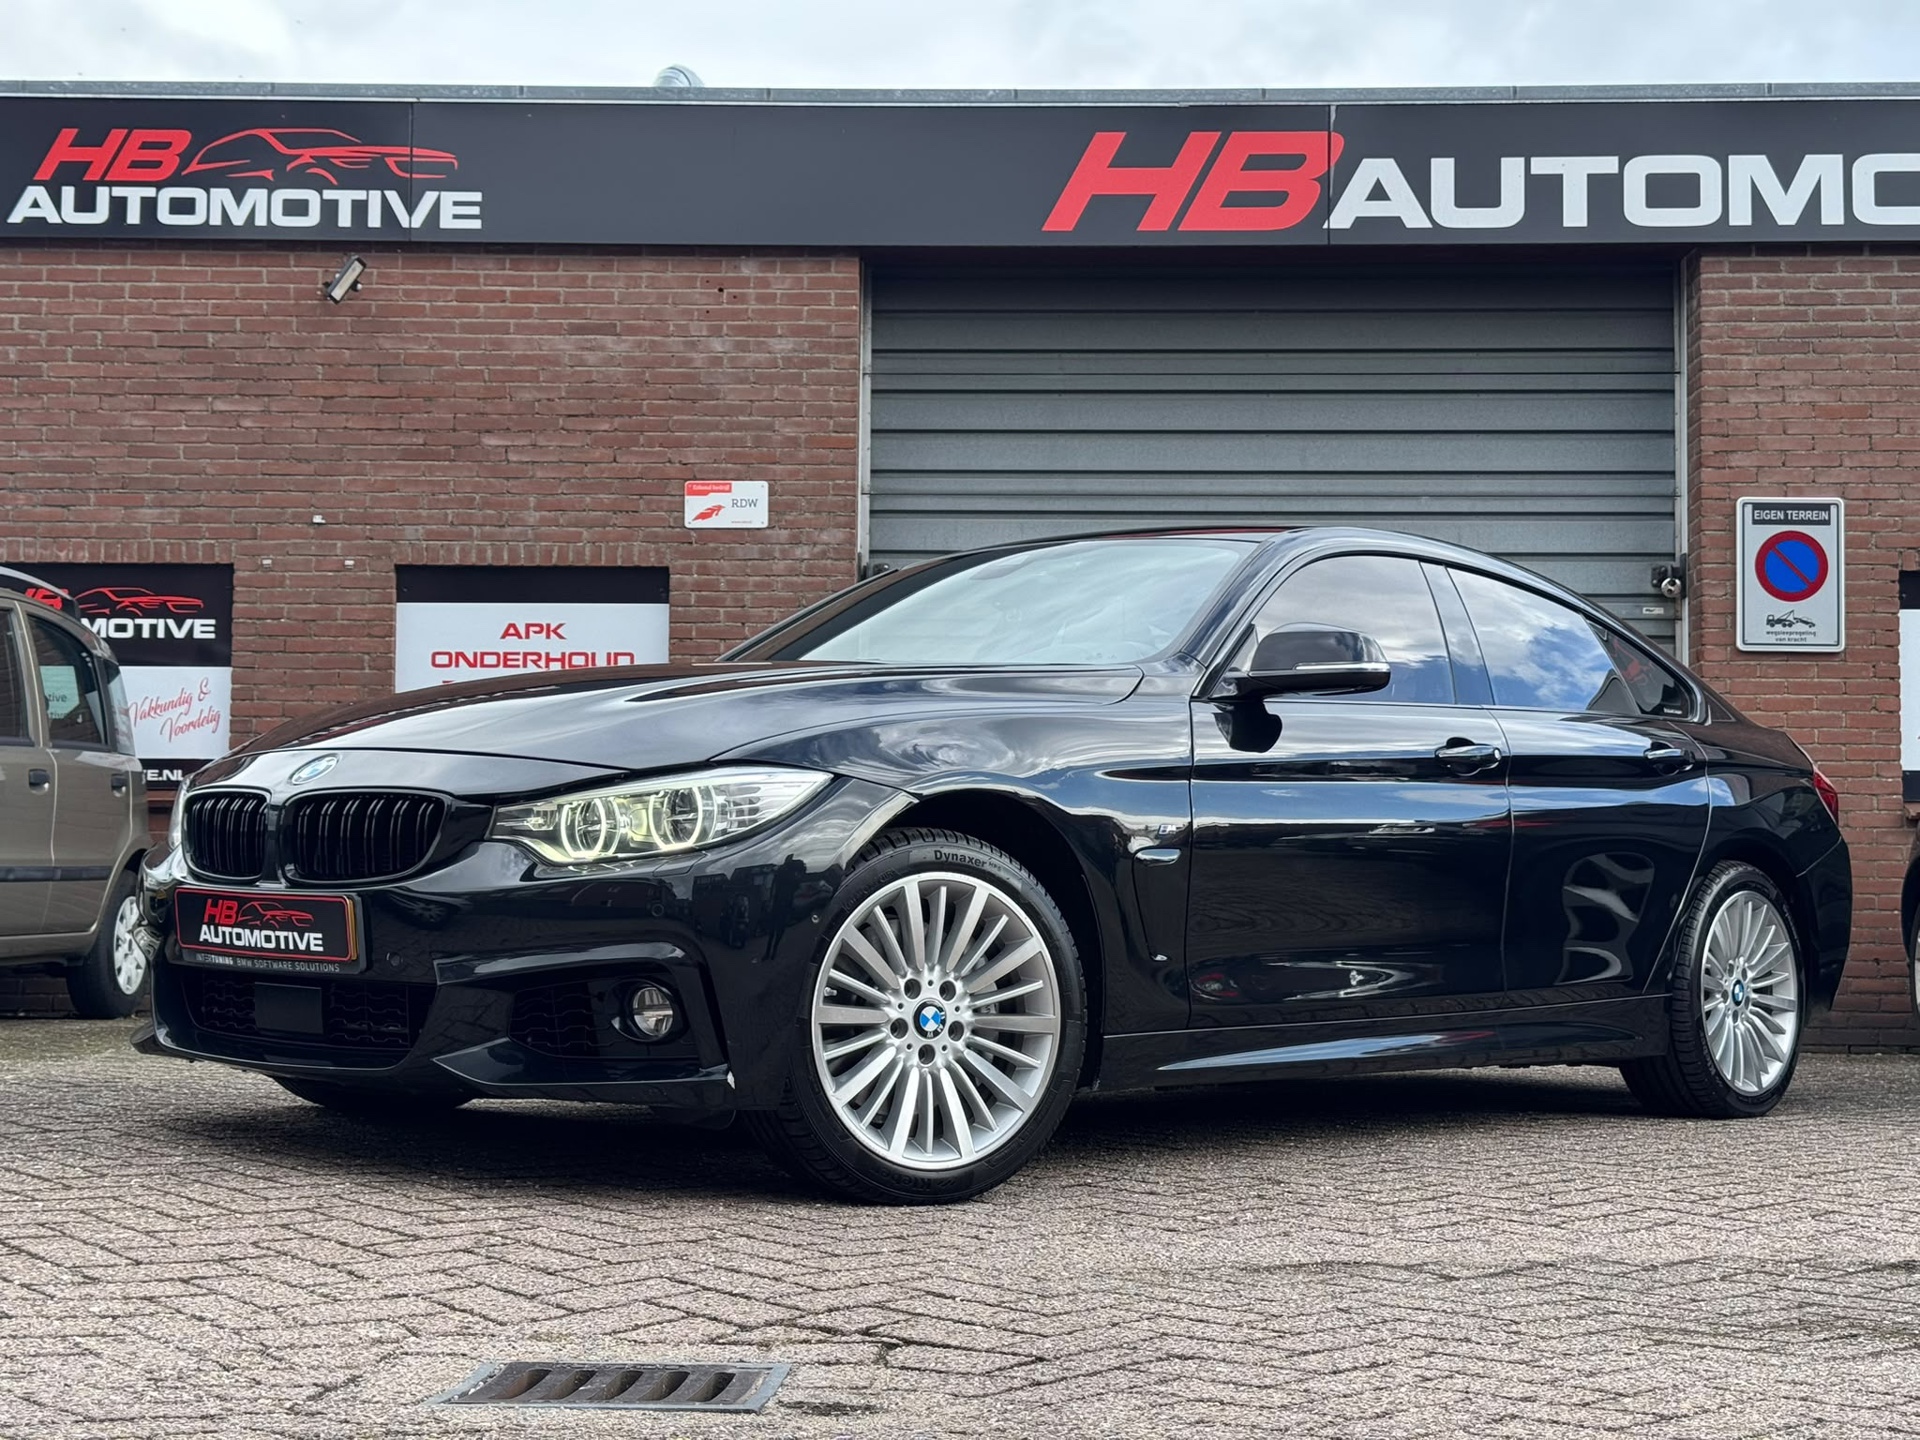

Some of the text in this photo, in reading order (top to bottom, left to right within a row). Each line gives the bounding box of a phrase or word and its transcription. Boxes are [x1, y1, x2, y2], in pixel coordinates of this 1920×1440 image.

[33, 128, 193, 182] HB
[1041, 130, 1920, 232] HB AUTOMO
[6, 184, 483, 230] AUTOMOTIVE
[731, 498, 759, 508] RDW
[1754, 510, 1829, 521] EIGEN TERREIN
[500, 622, 567, 640] APK
[128, 687, 194, 727] Vakkundig
[159, 705, 221, 743] Voordelig
[143, 769, 185, 782] E.NL
[934, 849, 987, 868] Dynaxer
[204, 899, 238, 925] HB
[199, 924, 324, 952] AUTOMOTIVE
[236, 958, 252, 967] BMW
[254, 959, 293, 970] SOFTWARE
[295, 962, 340, 972] SOLUTIONS
